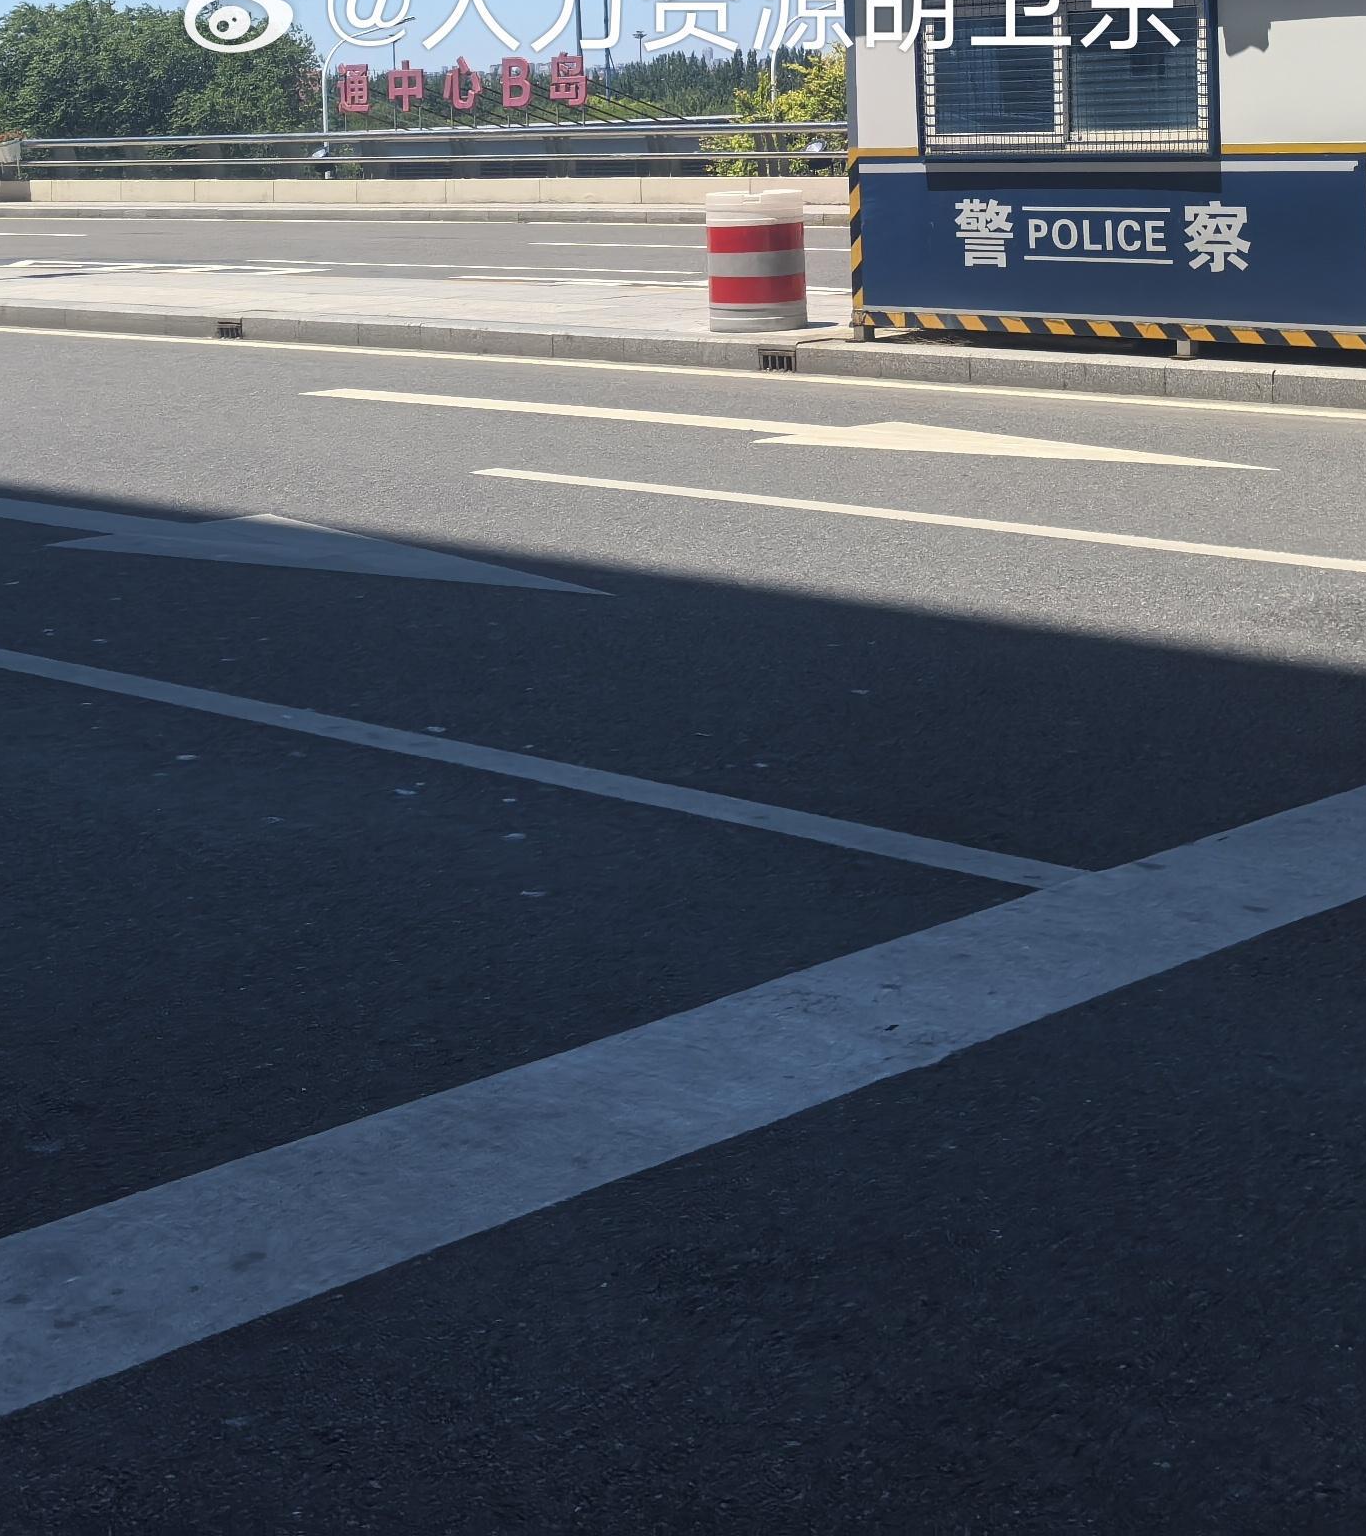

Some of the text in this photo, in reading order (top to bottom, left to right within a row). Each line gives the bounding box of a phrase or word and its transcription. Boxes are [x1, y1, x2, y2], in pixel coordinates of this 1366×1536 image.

[295, 52, 588, 114] 通中心B岛
[955, 199, 1251, 272] 警 POLICE 察
